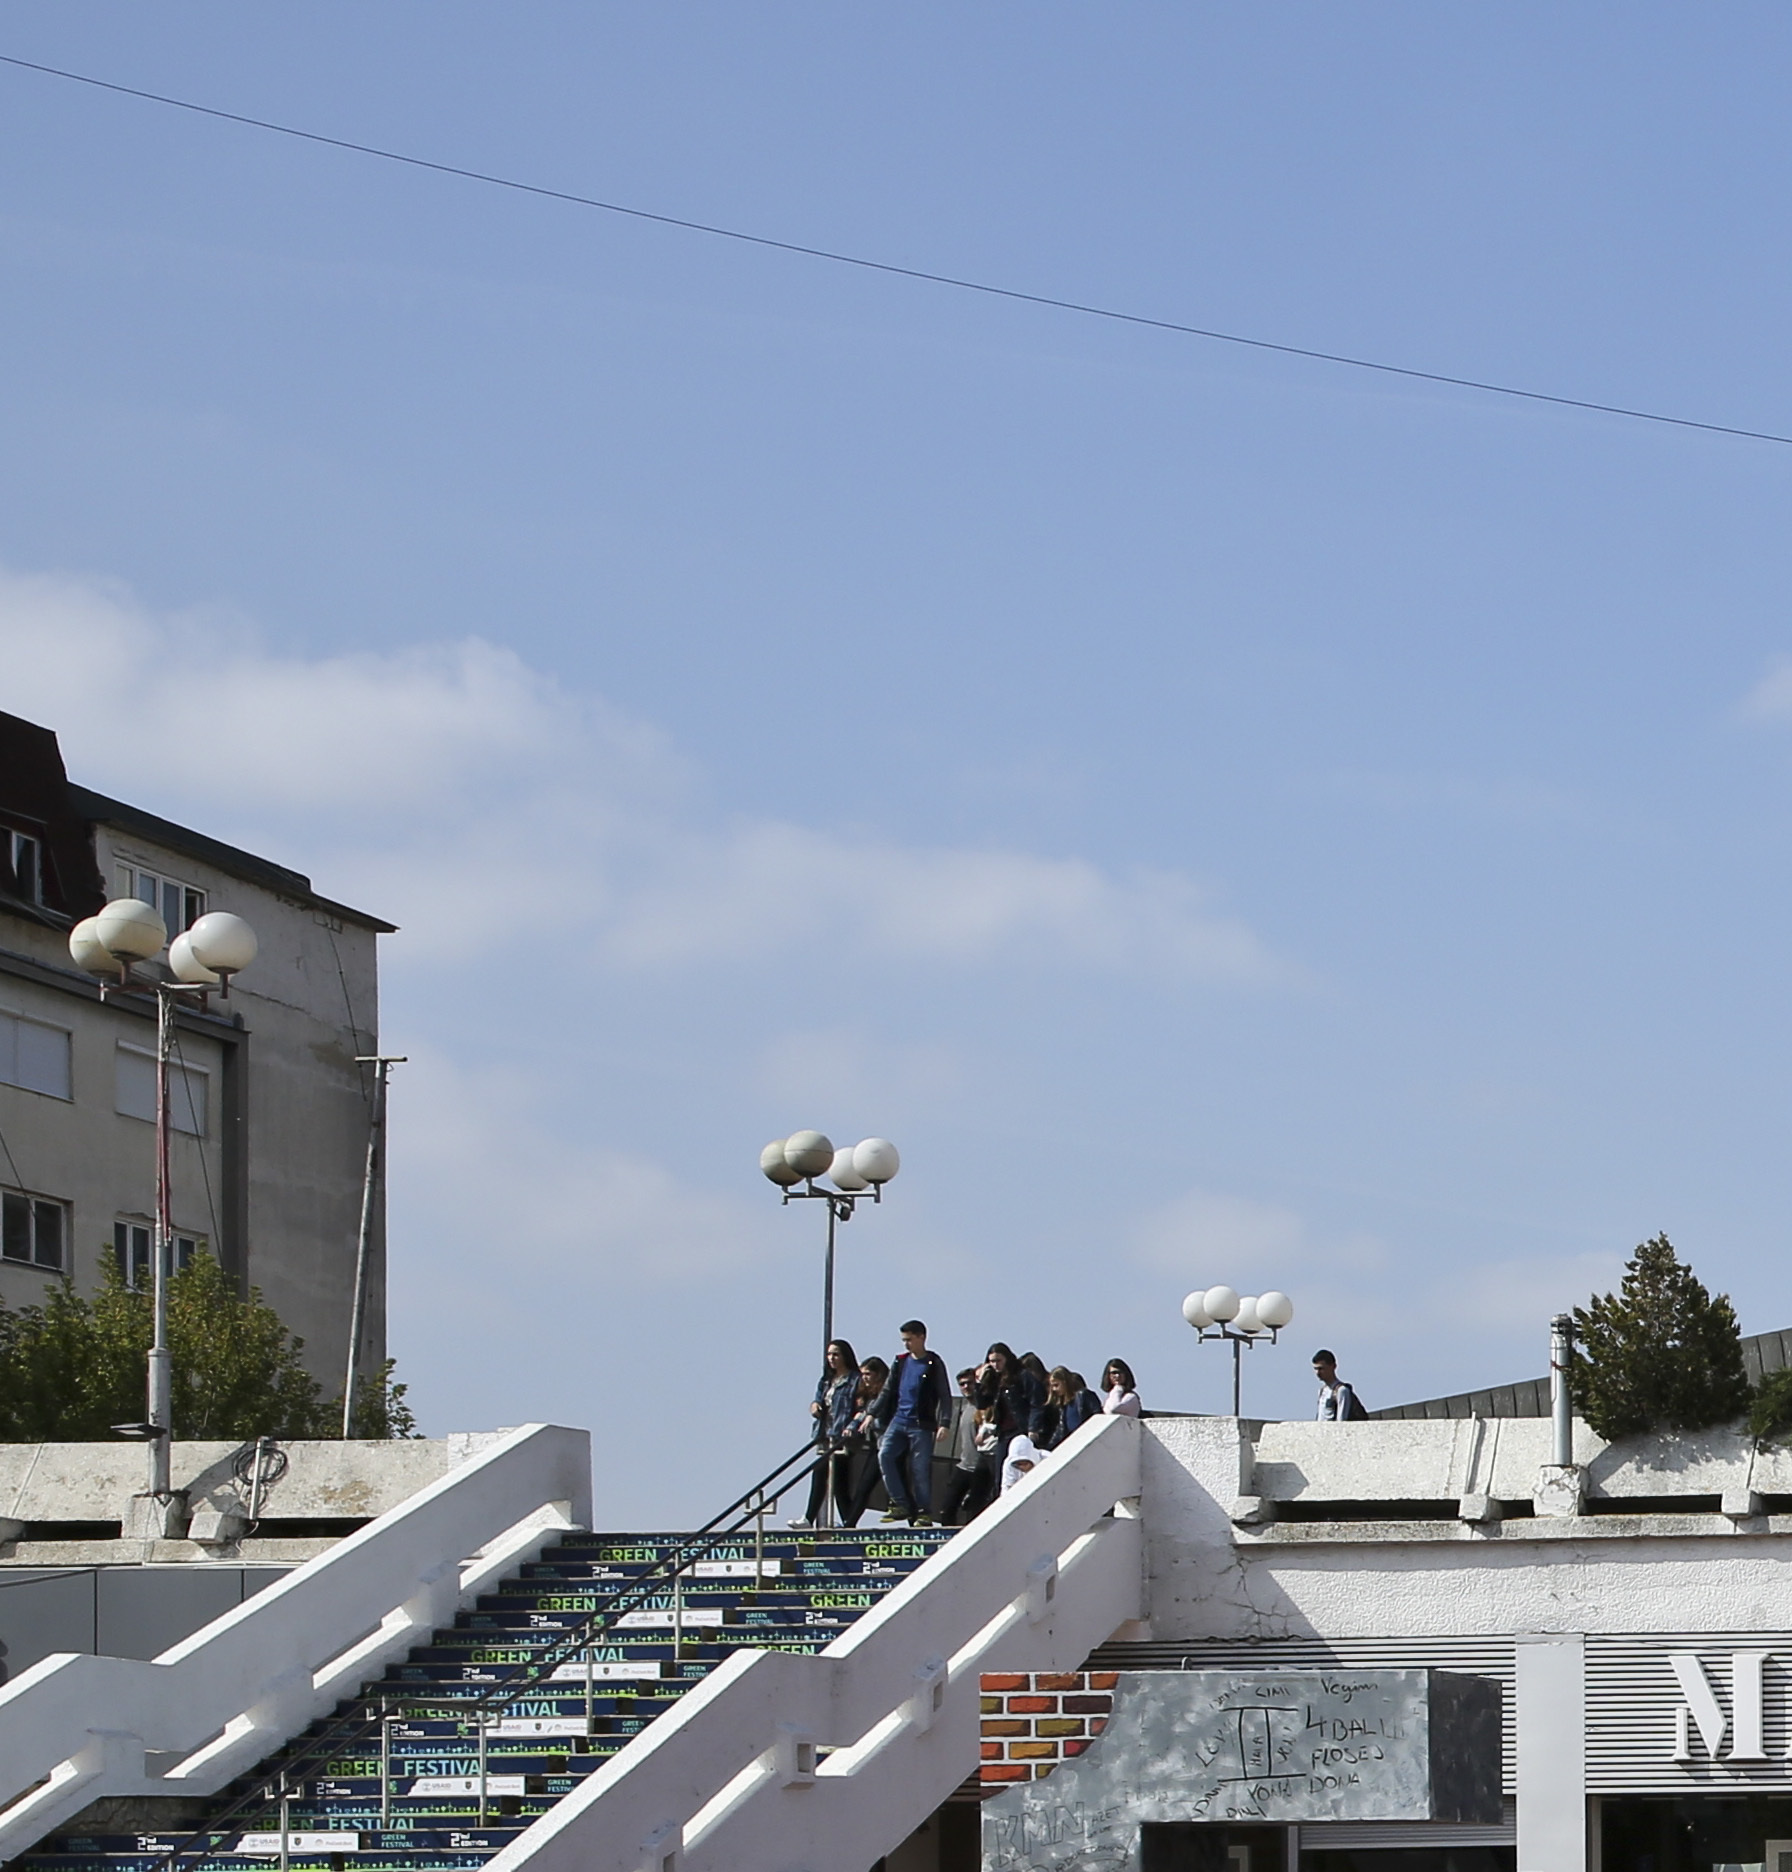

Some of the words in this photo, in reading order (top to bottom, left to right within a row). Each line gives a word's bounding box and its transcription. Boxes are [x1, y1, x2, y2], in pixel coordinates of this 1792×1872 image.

[600, 1549, 657, 1561] GREEN
[866, 1545, 925, 1557] GREEN
[537, 1598, 596, 1610] GREEN
[810, 1595, 870, 1608] GREEN
[471, 1650, 531, 1662] GREEN
[544, 1648, 627, 1661] FESTVAL
[404, 1760, 492, 1776] FESTIVA
[252, 1819, 314, 1830] GREN
